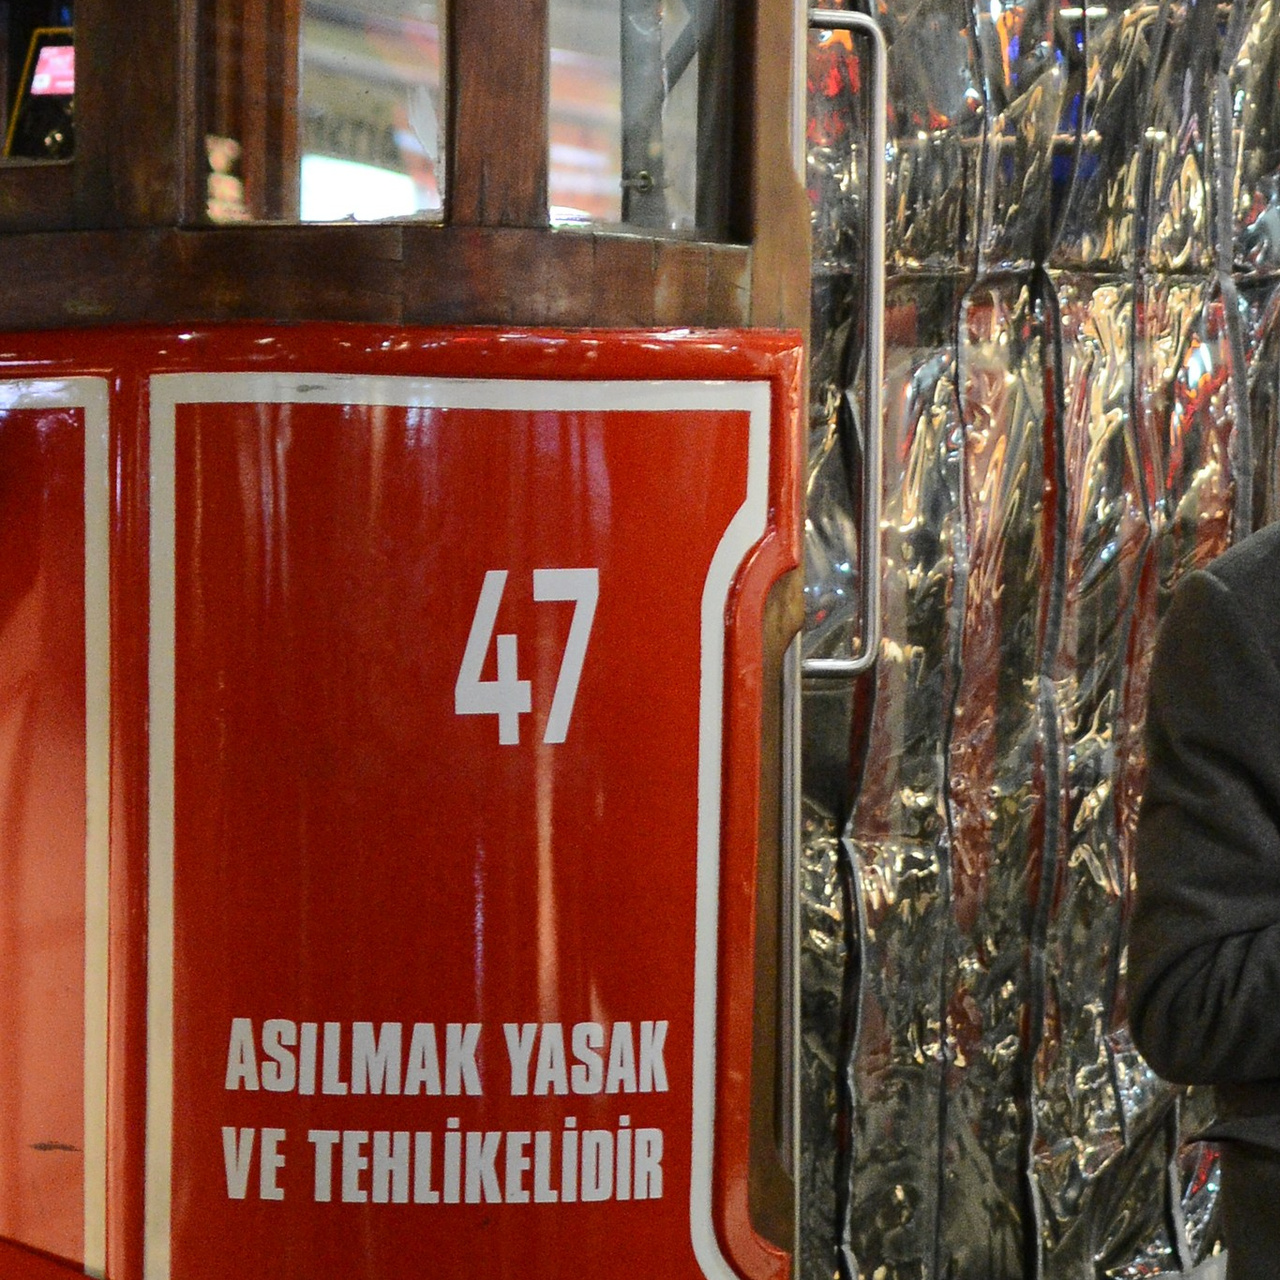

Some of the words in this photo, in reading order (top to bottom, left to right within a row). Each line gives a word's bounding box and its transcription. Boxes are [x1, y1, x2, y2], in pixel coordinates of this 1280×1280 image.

[453, 568, 601, 746] 47
[224, 1017, 484, 1097] ASILMAK
[503, 1020, 670, 1095] YASAK
[221, 1125, 287, 1202] VE
[307, 1115, 665, 1205] TEHLİKELİDİR
